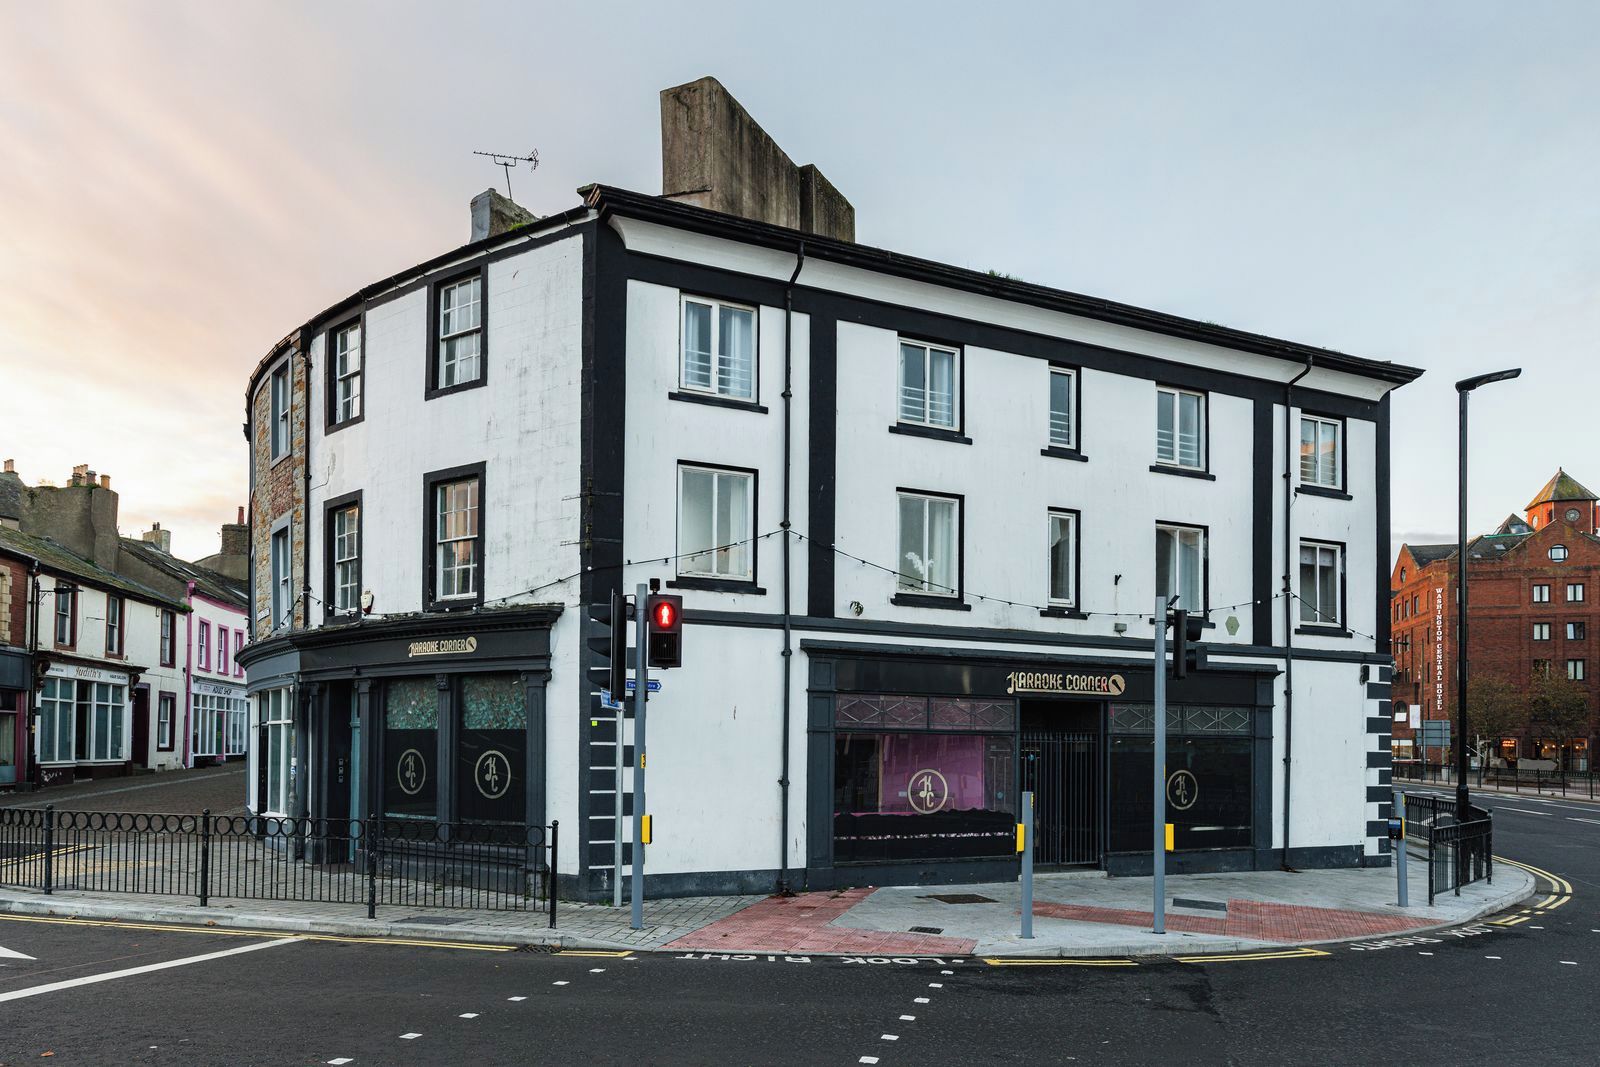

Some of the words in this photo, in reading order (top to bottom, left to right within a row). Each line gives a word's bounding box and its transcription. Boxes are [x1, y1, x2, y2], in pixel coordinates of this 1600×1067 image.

[1435, 588, 1443, 642] WASHINGTON
[408, 641, 439, 658] KARAOKE
[440, 639, 466, 652] CORNER
[1006, 672, 1063, 694] KARAOKE
[1066, 674, 1108, 692] CORNER
[675, 953, 811, 963] RIGHT
[841, 956, 946, 965] LOOK
